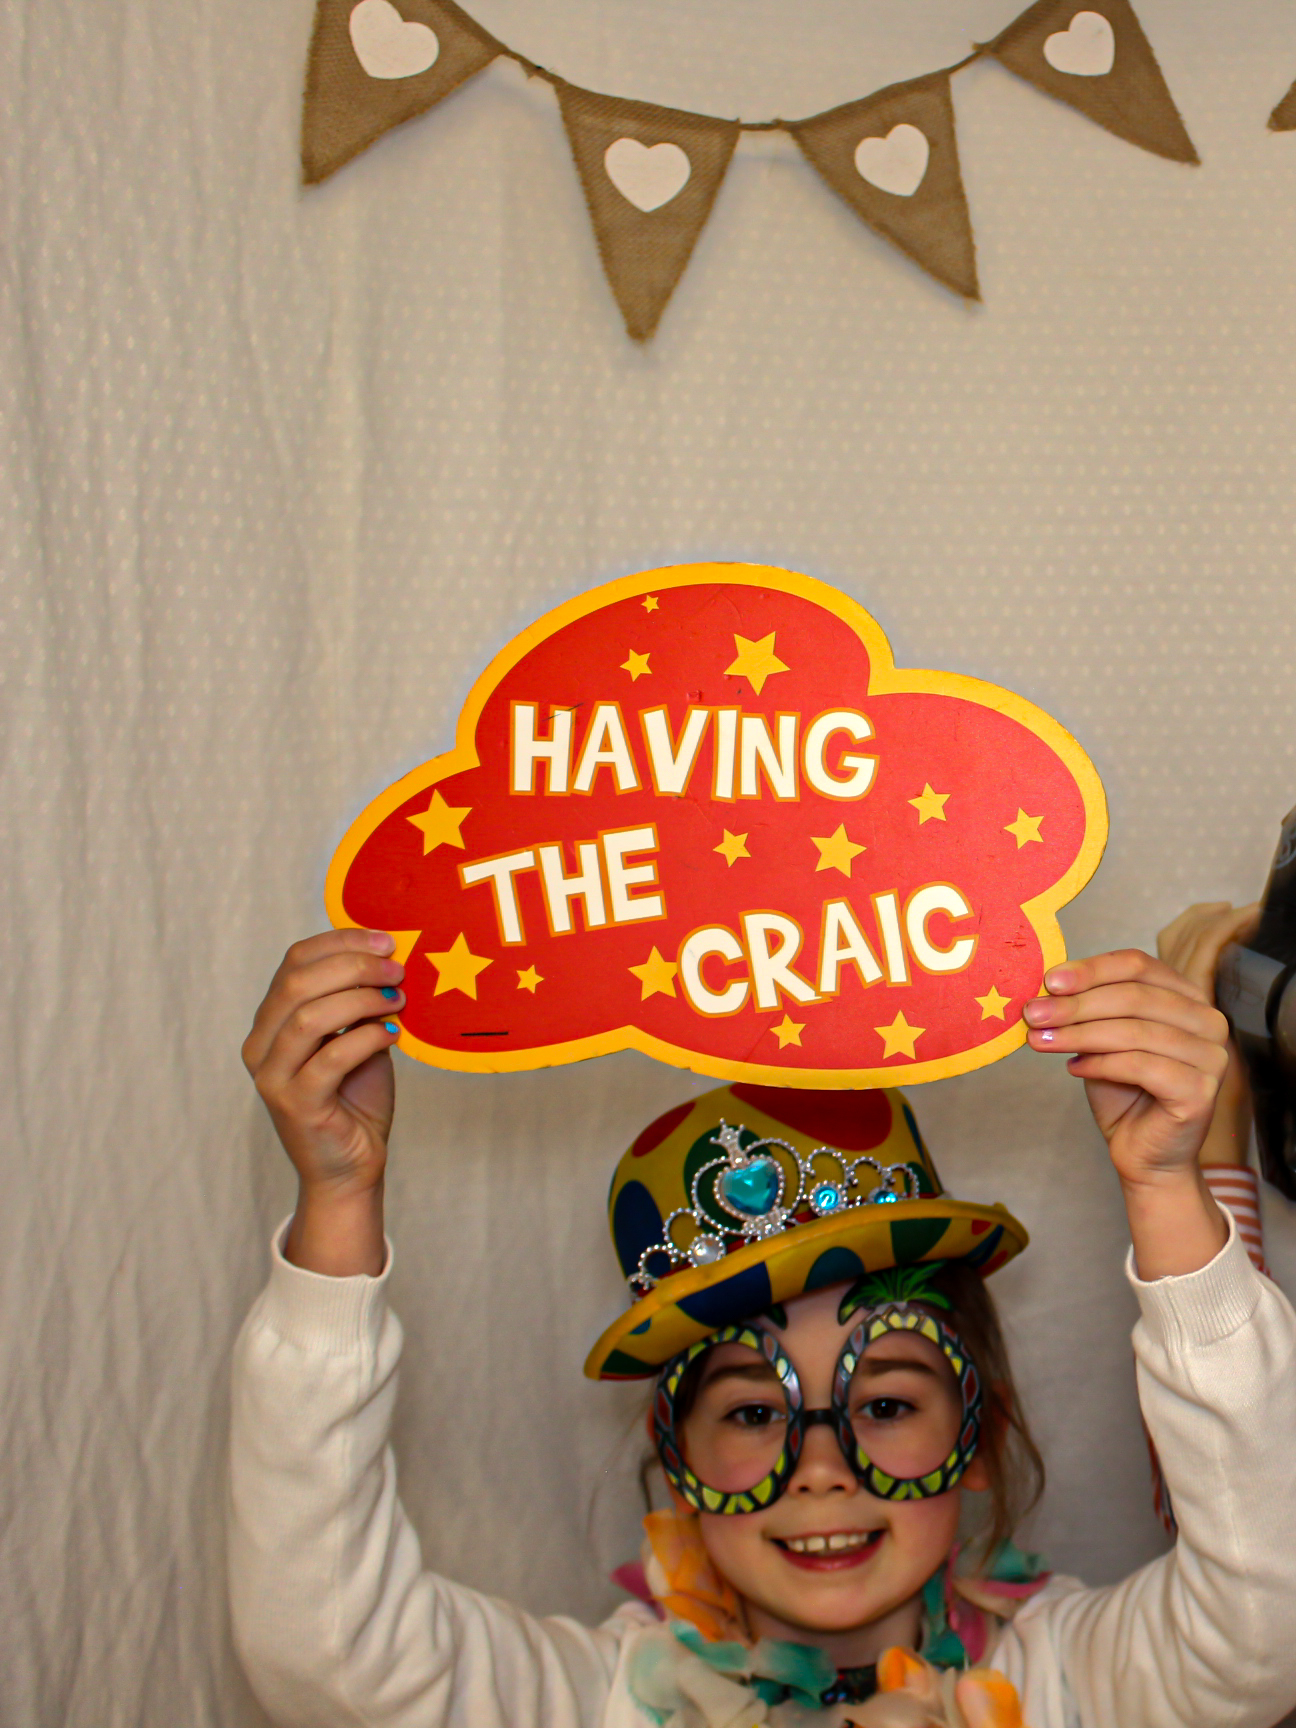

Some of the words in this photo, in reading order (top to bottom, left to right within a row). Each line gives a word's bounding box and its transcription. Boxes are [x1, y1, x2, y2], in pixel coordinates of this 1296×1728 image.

[511, 702, 876, 800] HAVING
[461, 825, 665, 945] THE
[679, 883, 977, 1015] CRAIC
